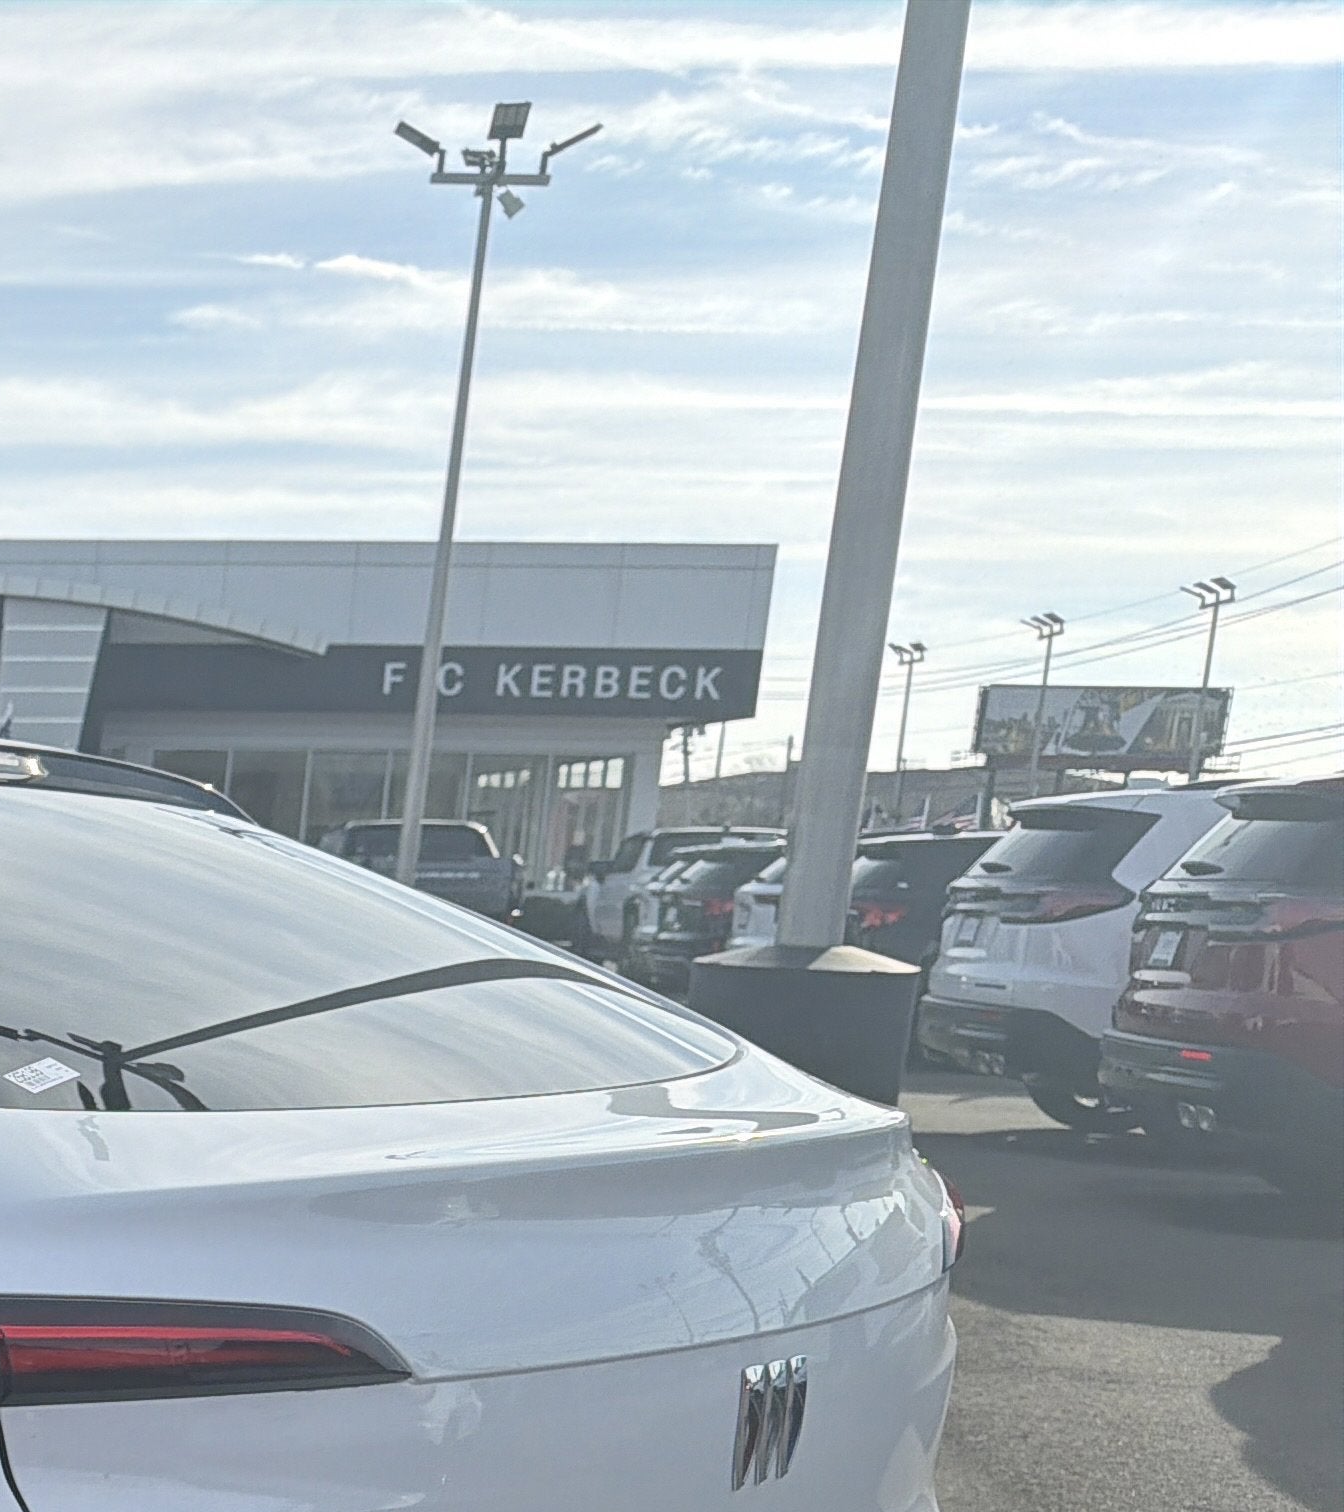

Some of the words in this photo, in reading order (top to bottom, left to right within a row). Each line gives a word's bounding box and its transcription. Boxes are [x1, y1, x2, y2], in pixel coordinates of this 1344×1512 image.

[383, 661, 406, 695] F
[437, 661, 464, 696] C
[495, 662, 722, 701] KERBECK
